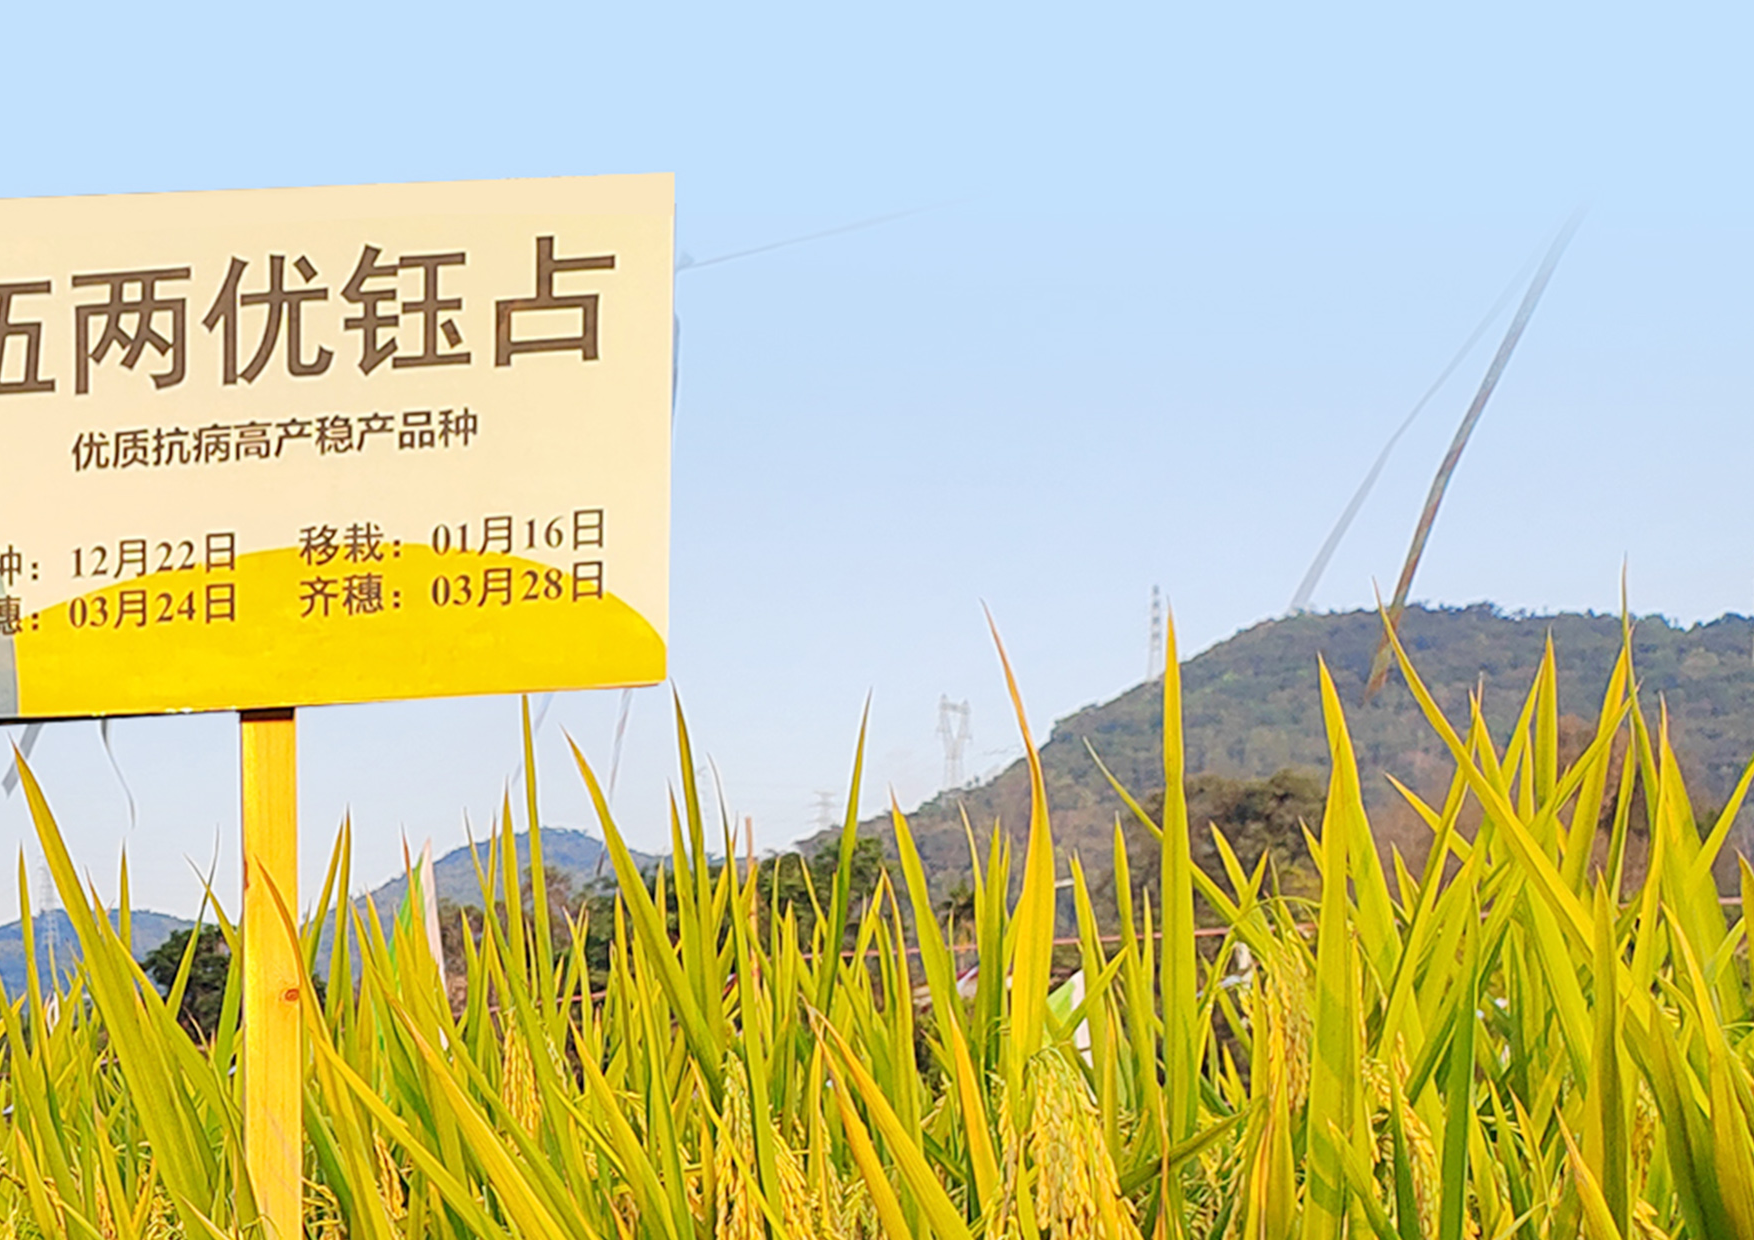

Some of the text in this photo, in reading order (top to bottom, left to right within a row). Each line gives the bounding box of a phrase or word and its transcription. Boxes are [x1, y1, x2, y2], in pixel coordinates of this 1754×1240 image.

[71, 406, 478, 472] 优质抗病高产稳产品种
